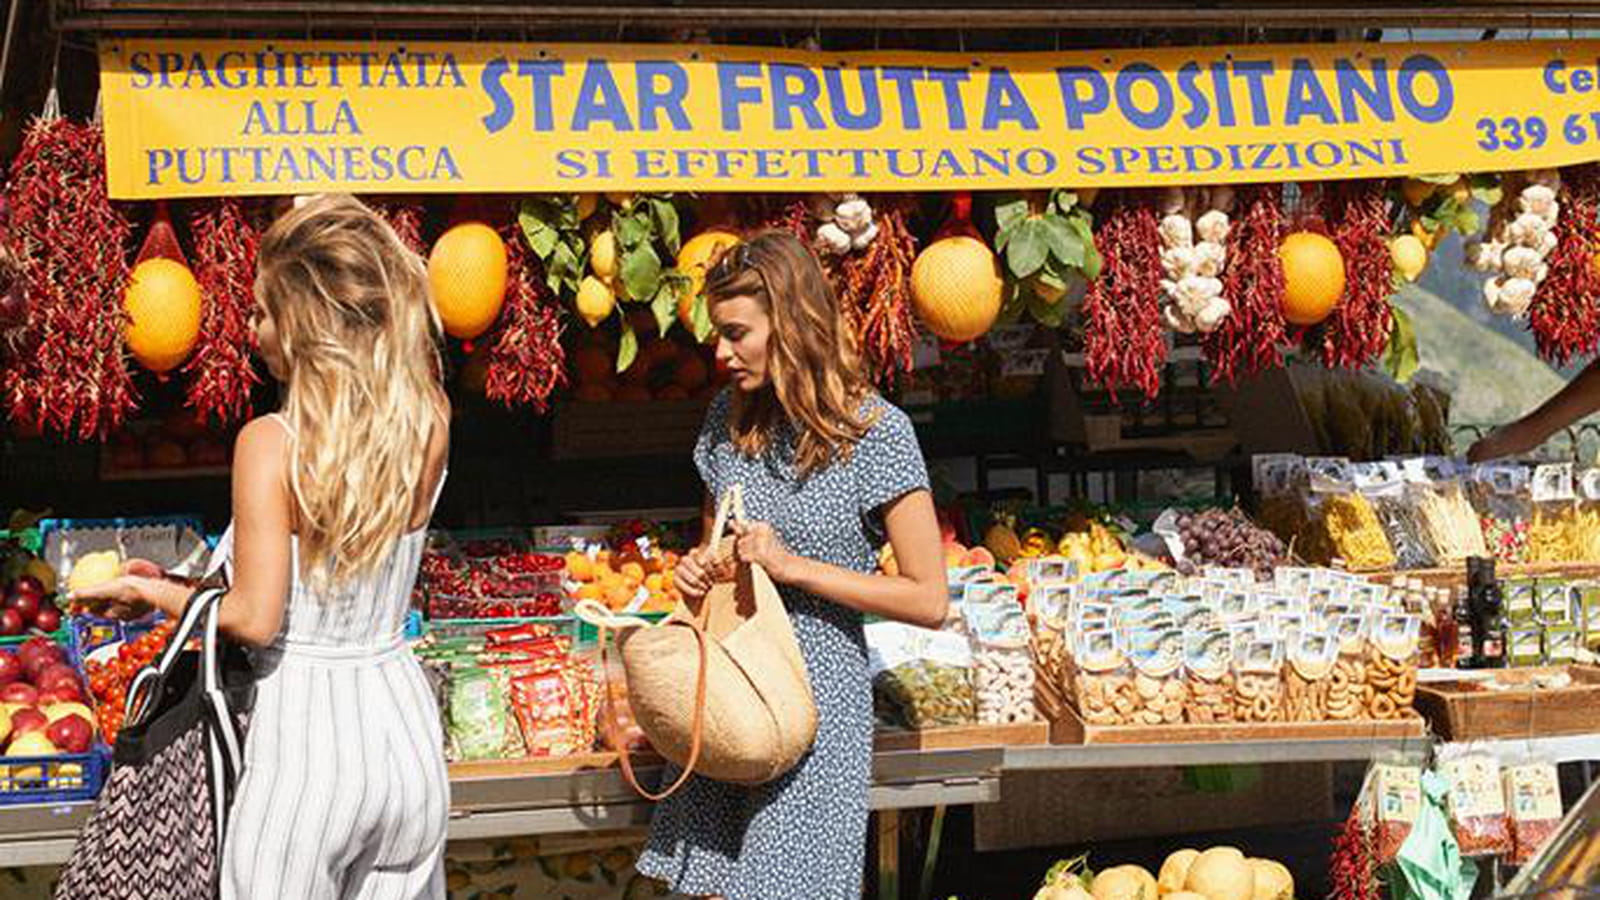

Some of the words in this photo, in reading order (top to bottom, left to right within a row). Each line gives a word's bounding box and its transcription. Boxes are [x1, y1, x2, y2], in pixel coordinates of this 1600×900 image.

[130, 50, 466, 89] SPAGHETTATA
[480, 58, 693, 134] STAR
[717, 60, 1040, 132] FRUTTA
[1055, 53, 1455, 131] POSITANO
[242, 99, 363, 136] ALLA
[1475, 116, 1548, 152] 339
[146, 145, 462, 185] PUTTANESCA
[555, 149, 614, 179] SI
[632, 147, 1058, 179] EFFETTUANO
[1076, 138, 1409, 175] SPEDIZIONI
